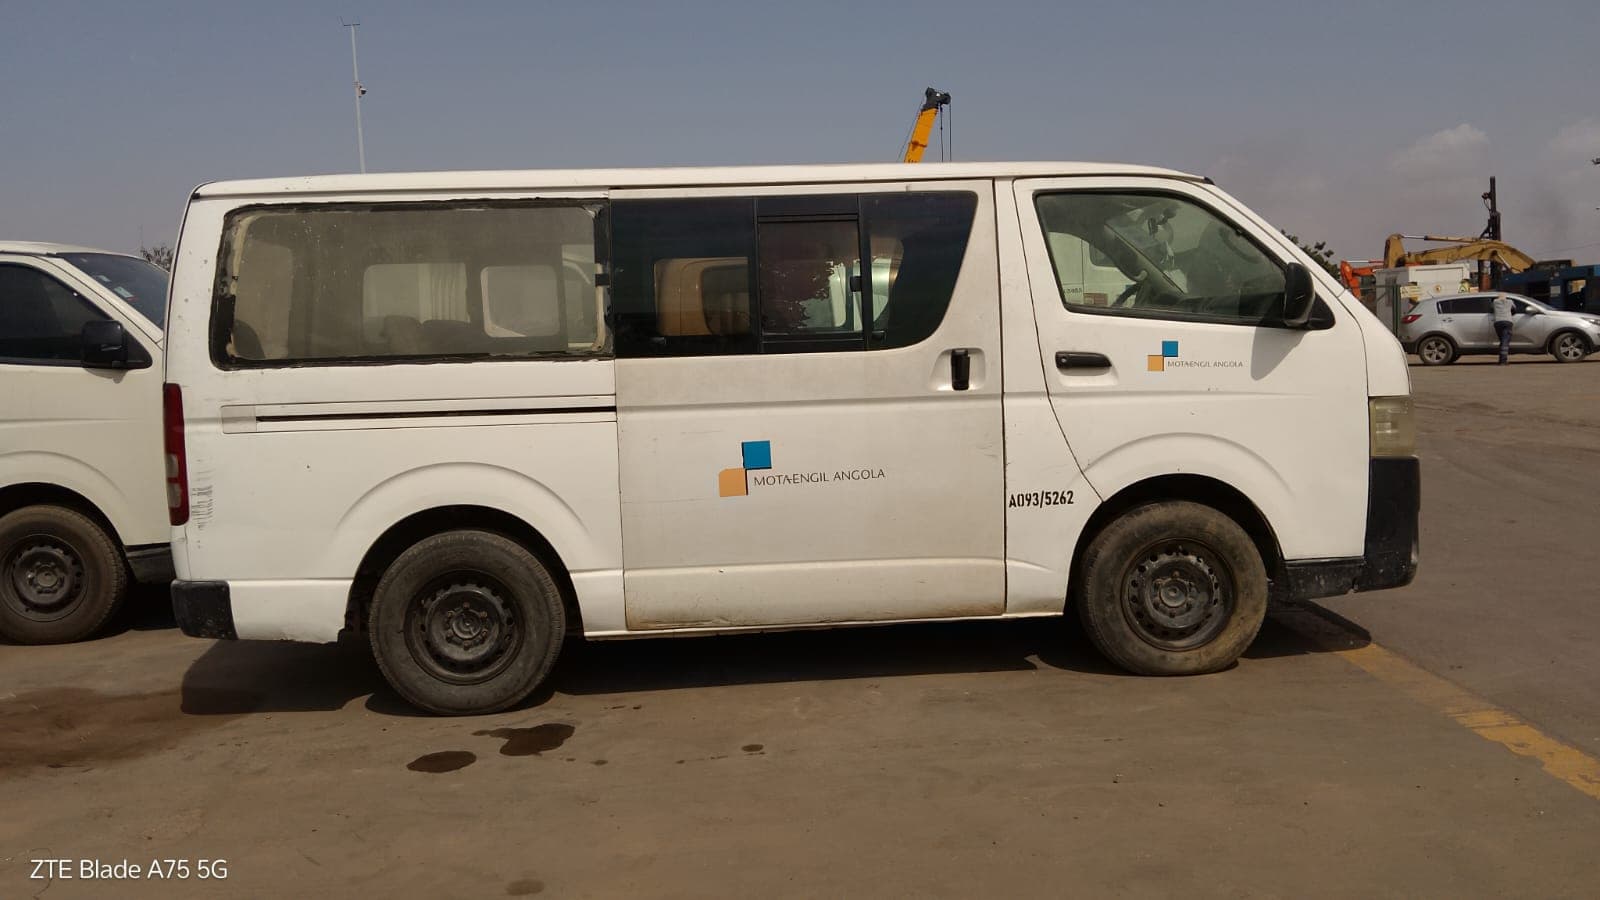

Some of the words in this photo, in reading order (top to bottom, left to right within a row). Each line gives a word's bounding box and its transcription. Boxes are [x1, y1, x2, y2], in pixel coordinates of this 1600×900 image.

[1213, 360, 1243, 368] ANGOLA
[753, 472, 830, 487] MOTA-ENGIL
[833, 468, 886, 482] ANGOLA
[1008, 490, 1074, 509] A093/5262
